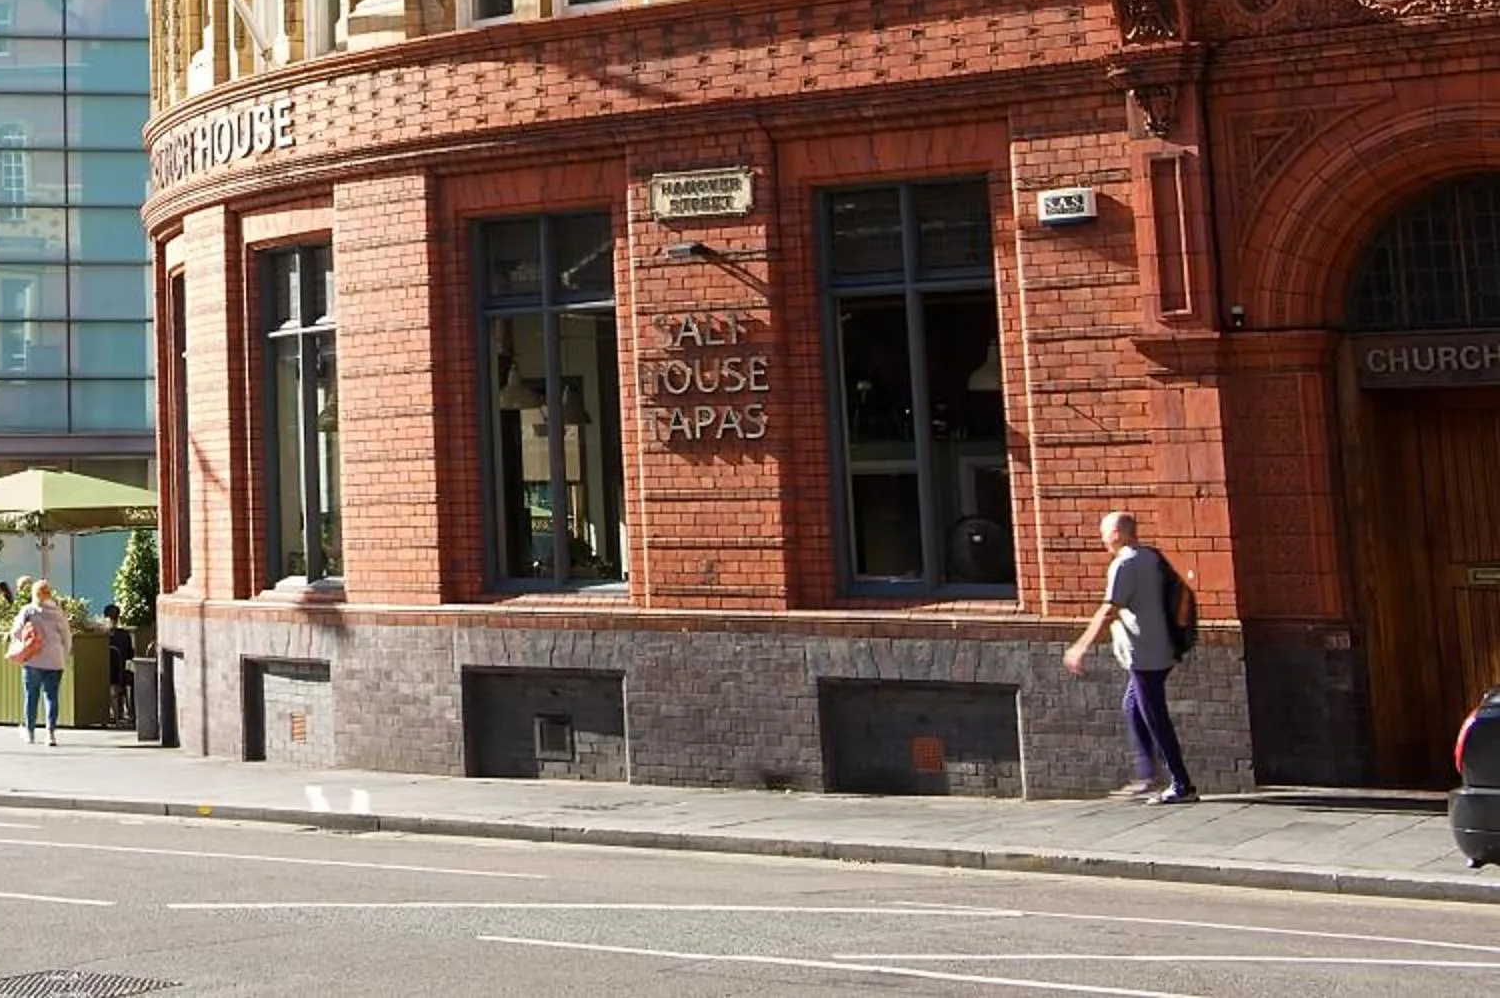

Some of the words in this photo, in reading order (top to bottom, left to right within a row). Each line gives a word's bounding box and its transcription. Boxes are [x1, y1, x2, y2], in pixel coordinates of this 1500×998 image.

[194, 98, 293, 171] HOUSE
[662, 177, 742, 195] HANOVER
[669, 196, 735, 214] STREET
[653, 311, 744, 347] SALT
[638, 356, 769, 394] HOUSE
[1366, 345, 1500, 372] CHURCH
[642, 404, 767, 440] TAPAS
